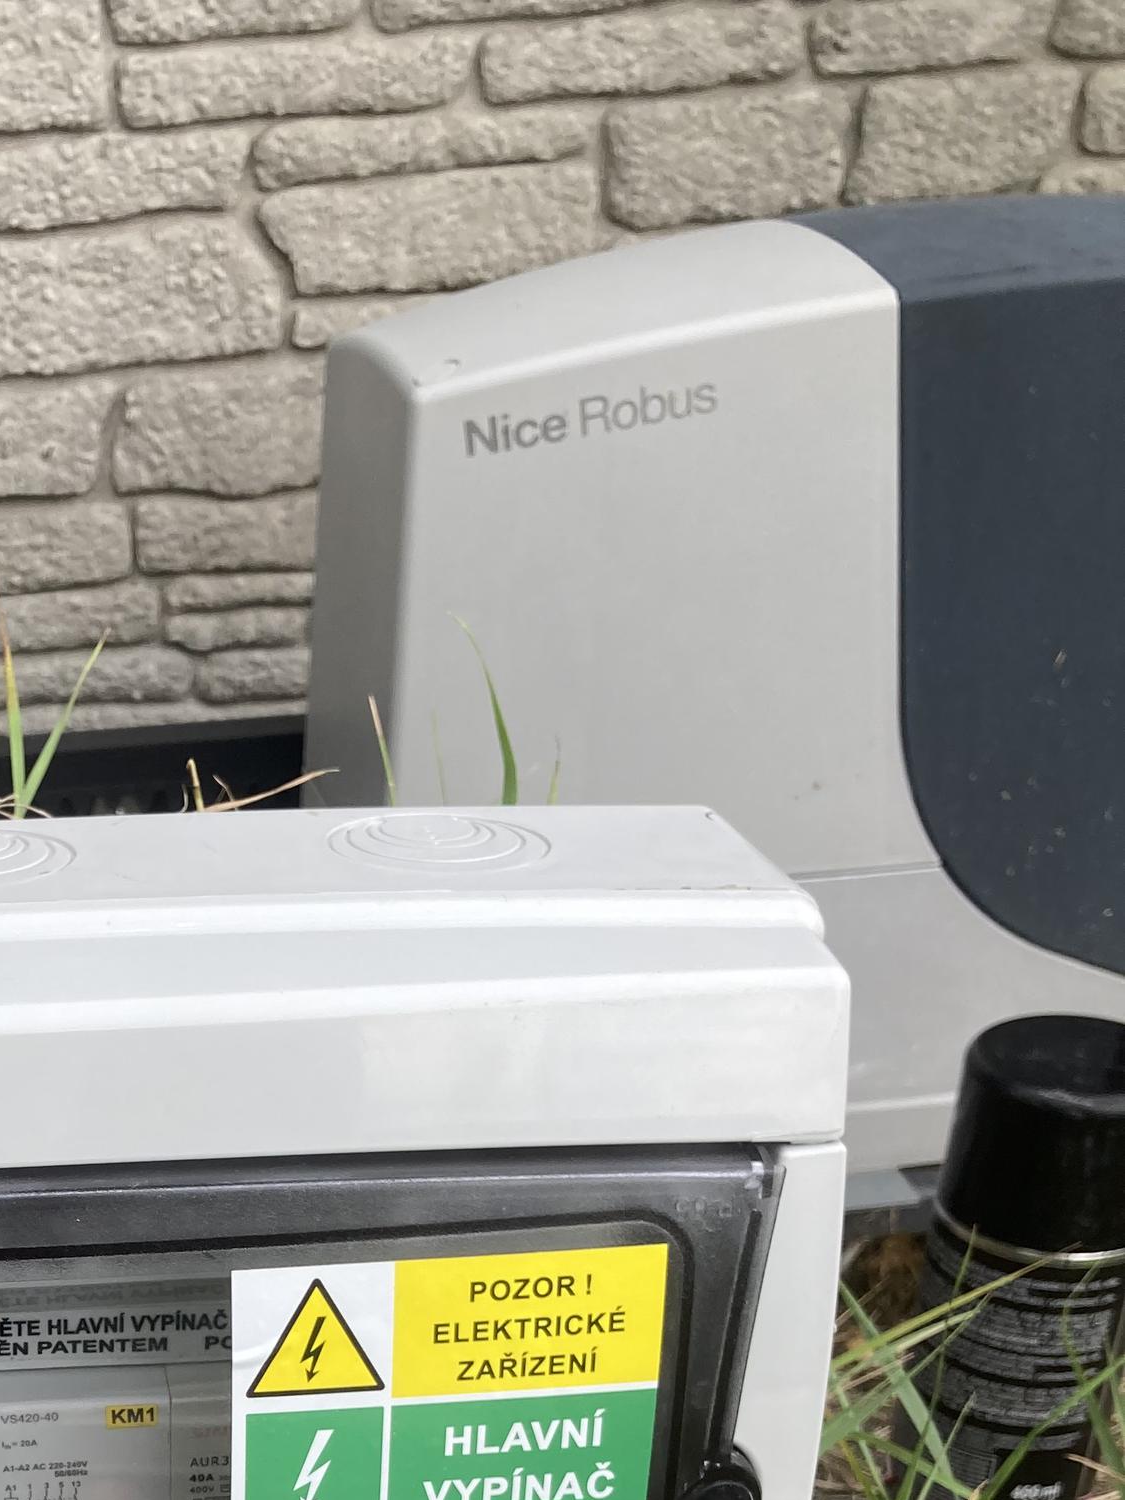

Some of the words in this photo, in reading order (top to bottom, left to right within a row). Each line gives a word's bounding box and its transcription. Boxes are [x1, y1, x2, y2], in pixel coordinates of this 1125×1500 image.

[462, 413, 568, 457] Nice
[578, 383, 718, 437] Robus
[469, 1276, 576, 1302] POZOR
[586, 1274, 594, 1295] !
[47, 1313, 125, 1336] HLAVNÍ
[131, 1309, 228, 1332] VYPÍNAČ
[433, 1306, 626, 1344] ELEKTRICKÉ
[37, 1337, 168, 1355] PATENTEM
[456, 1347, 598, 1381] ZAŘÍZENÍ
[0, 1412, 59, 1424] VS420-40
[110, 1407, 155, 1425] KM1
[443, 1409, 606, 1456] HLAVNÍ
